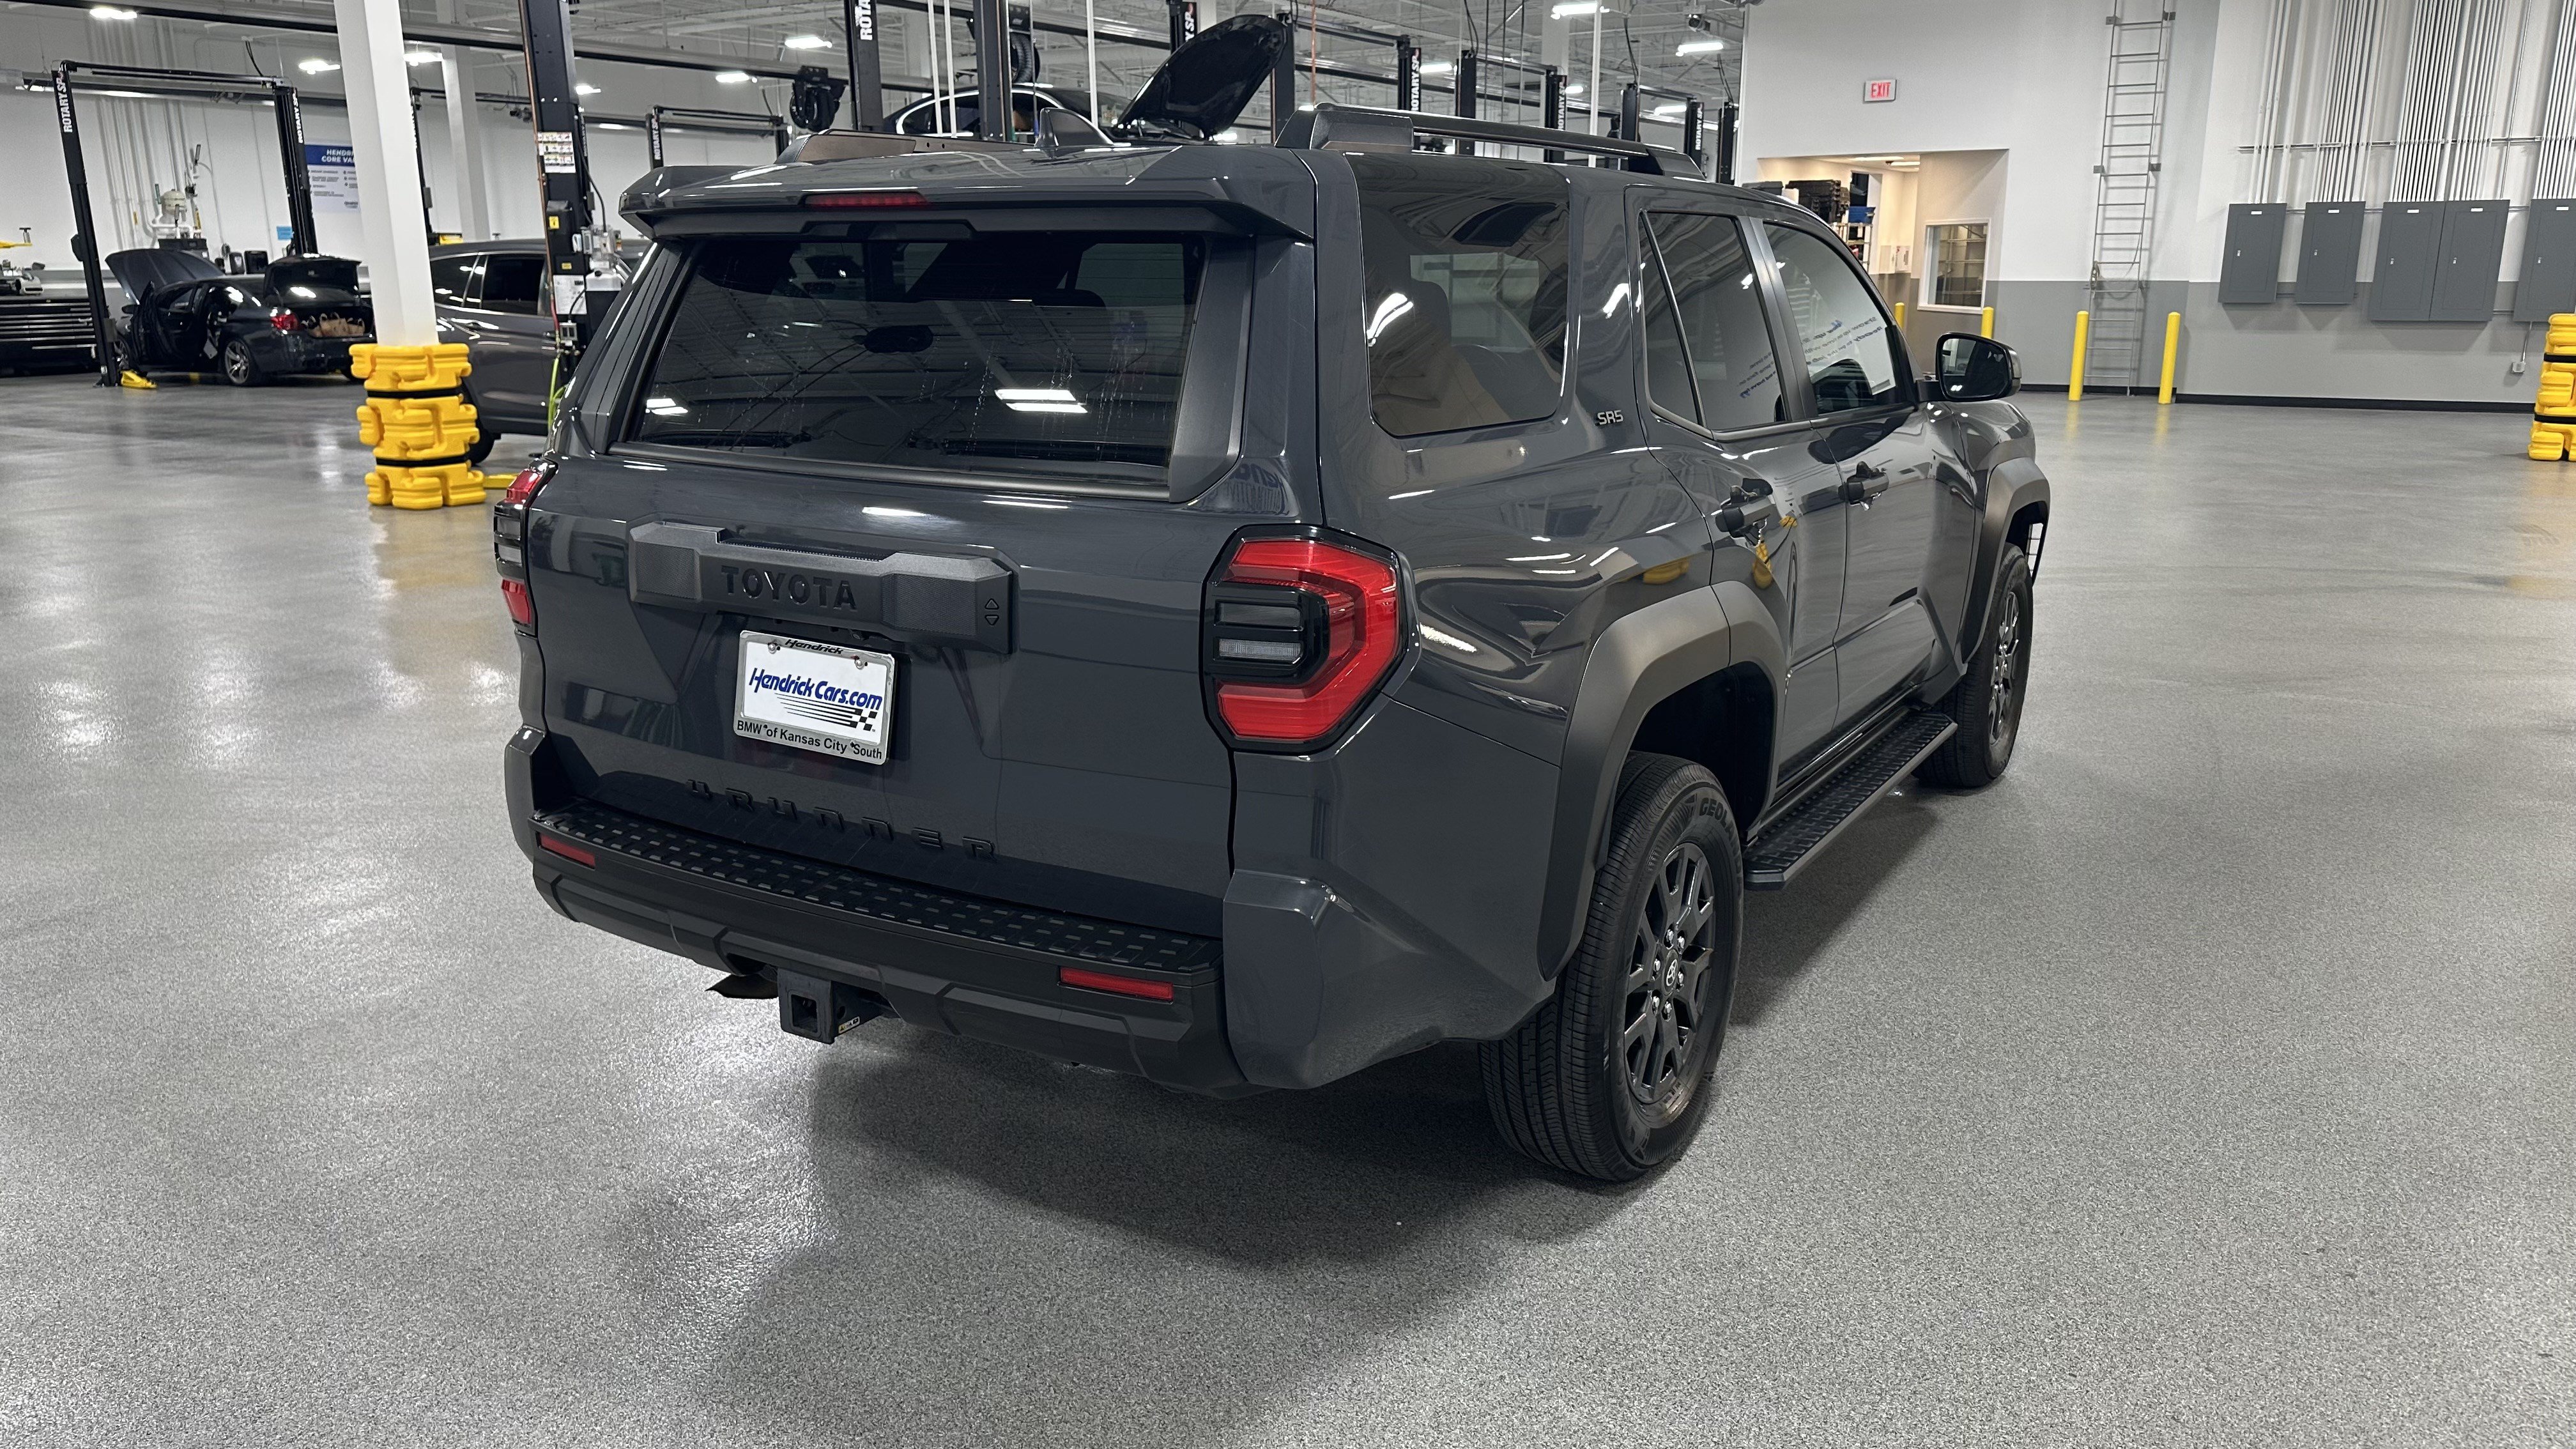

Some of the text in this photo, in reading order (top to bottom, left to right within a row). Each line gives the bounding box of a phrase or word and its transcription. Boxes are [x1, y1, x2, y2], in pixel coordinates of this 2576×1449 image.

[1871, 82, 1891, 98] EXIT
[58, 92, 72, 132] ROTARY
[1597, 410, 1623, 425] SR5
[721, 565, 857, 611] TOYOTA
[785, 639, 843, 655] Hendrick
[737, 720, 882, 760] BMW of Kansas City South
[686, 779, 995, 860] 4RUNNER
